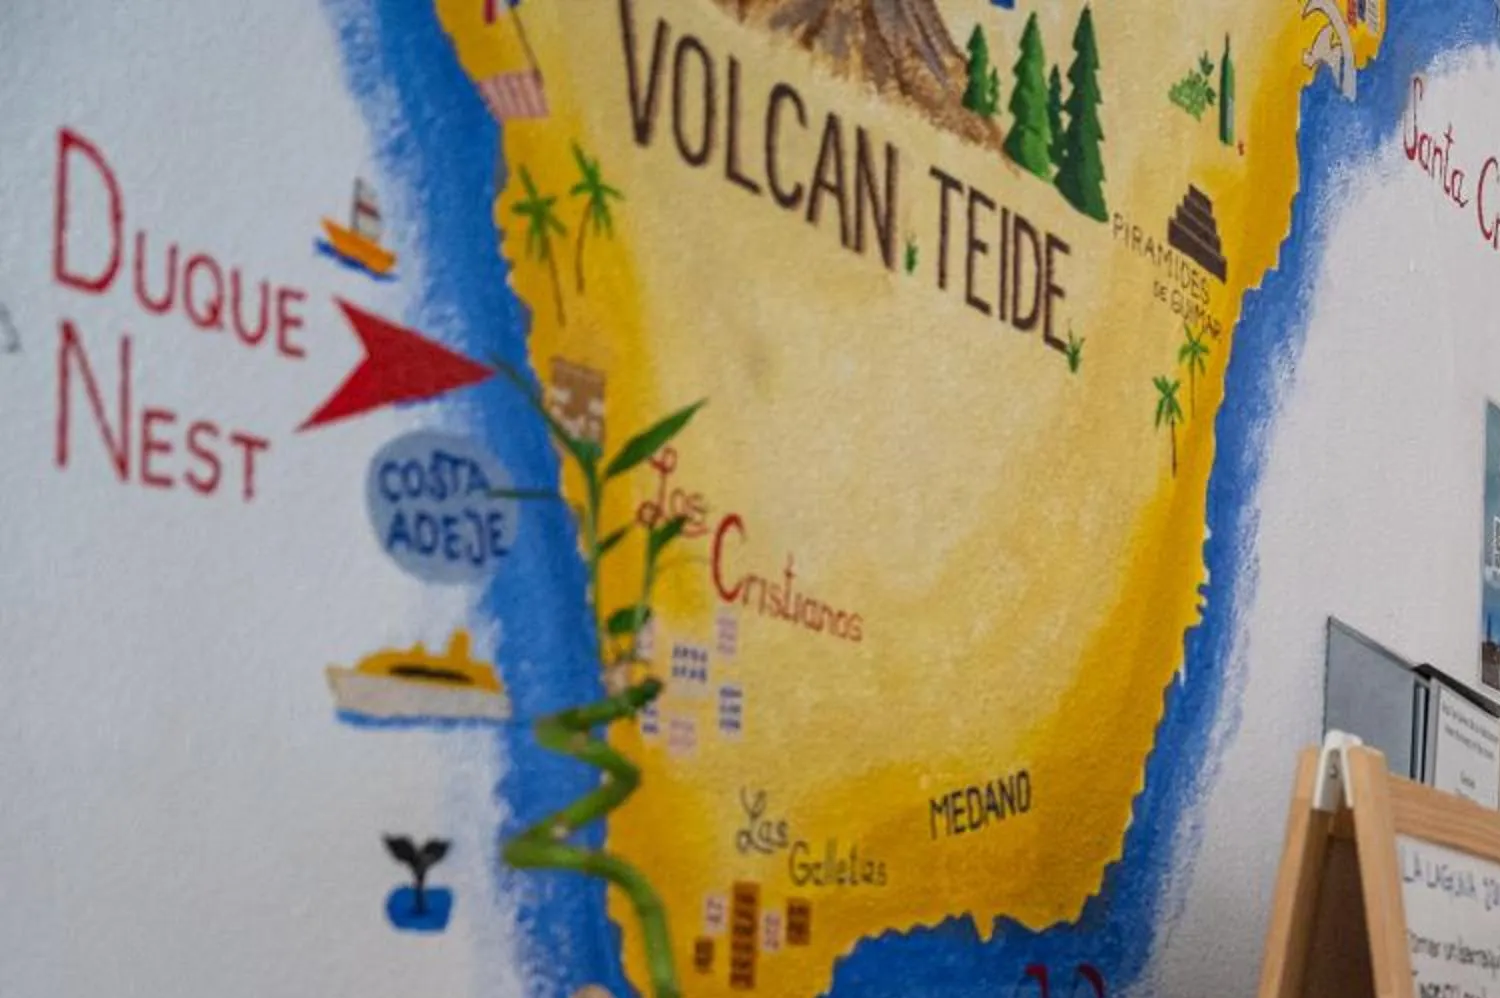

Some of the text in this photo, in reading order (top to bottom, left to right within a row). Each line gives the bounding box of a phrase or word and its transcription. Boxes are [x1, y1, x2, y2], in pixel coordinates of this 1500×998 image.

[619, 0, 1073, 354] VOLCAN TEIDE
[1402, 77, 1469, 208] Santa
[52, 126, 309, 361] DUQUE
[55, 318, 271, 502] NEST
[378, 450, 492, 503] COSTA
[386, 507, 511, 569] ADEJE
[711, 511, 864, 643] Cristianos
[928, 768, 1032, 840] MEDANO
